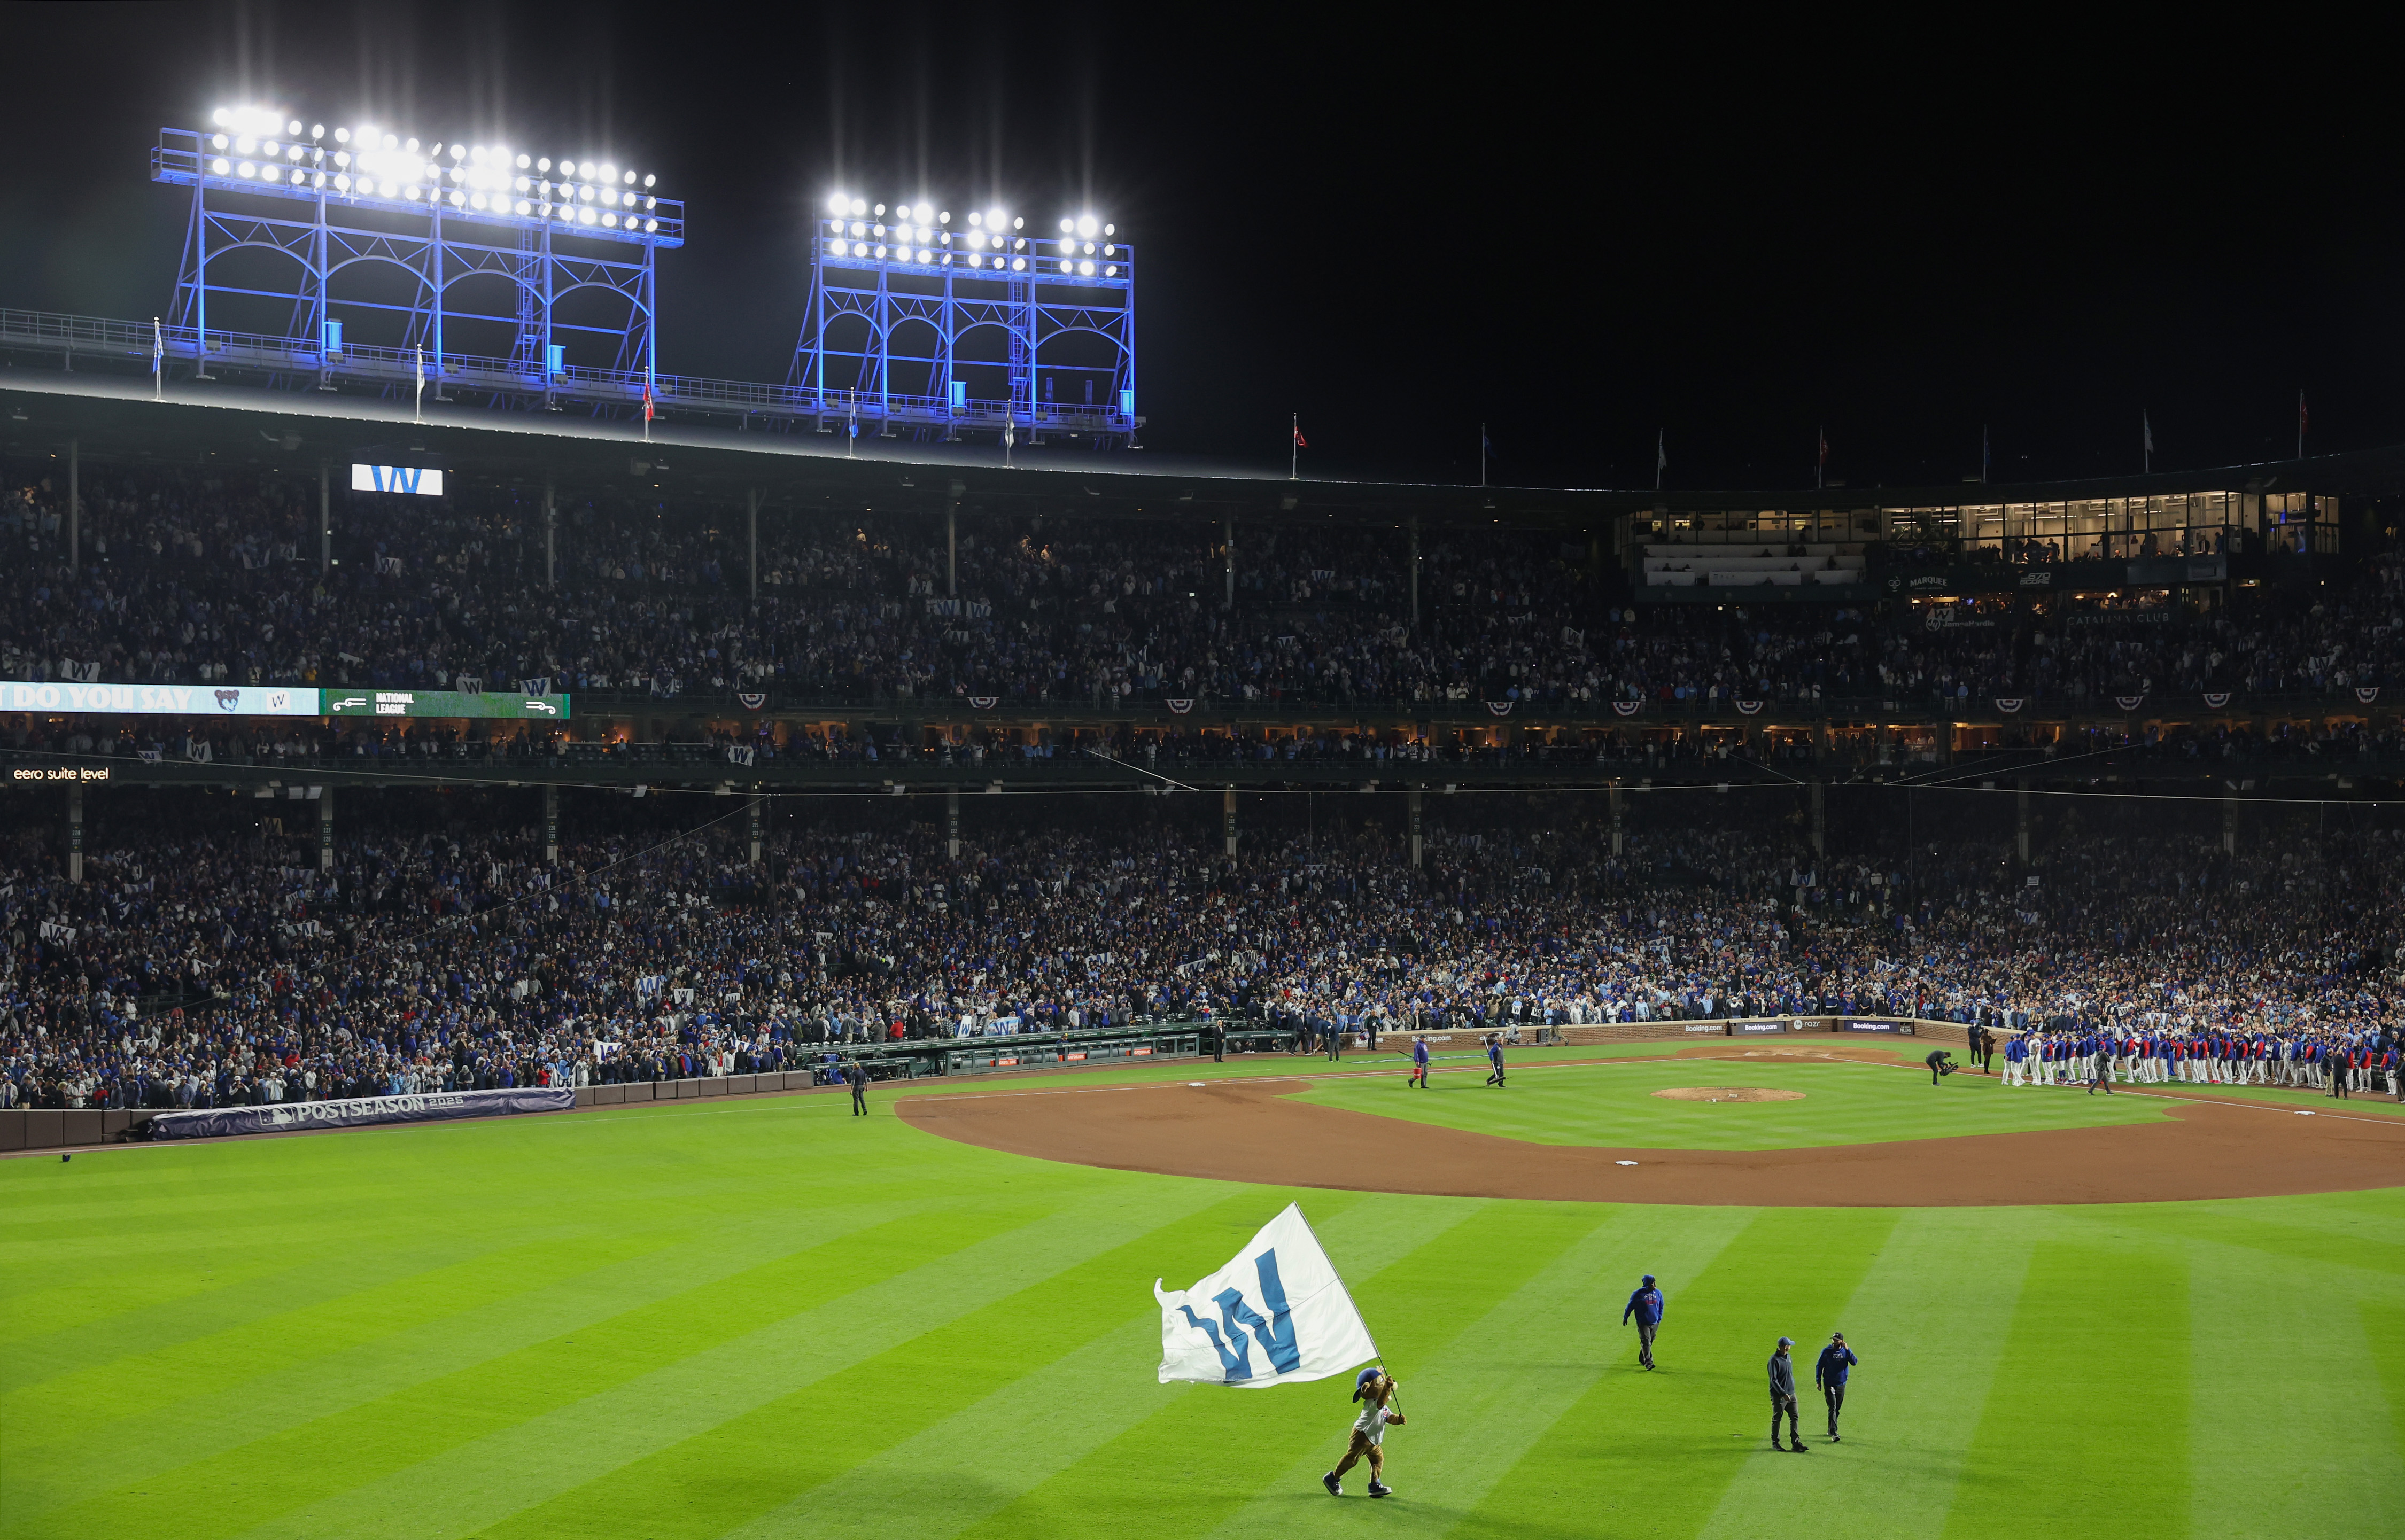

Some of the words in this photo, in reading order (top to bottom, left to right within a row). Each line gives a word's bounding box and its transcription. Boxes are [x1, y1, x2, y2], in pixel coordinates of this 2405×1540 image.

[371, 465, 422, 493] W
[1910, 577, 1948, 588] MARQUEE
[1934, 610, 1950, 620] W
[2137, 613, 2169, 623] CLUB
[72, 662, 92, 680] W
[463, 681, 480, 694] W
[523, 679, 545, 697] W
[15, 686, 60, 708] DO
[67, 687, 133, 710] YOU
[141, 688, 193, 711] SAY
[271, 694, 284, 707] W
[376, 693, 414, 703] NATIONAL
[376, 704, 406, 714] LEAGUE
[192, 742, 205, 760] W
[734, 748, 748, 763] W
[13, 769, 44, 780] eero
[47, 766, 77, 780] suite
[81, 767, 110, 780] level
[640, 977, 660, 998] W
[961, 1024, 970, 1035] W
[994, 1022, 1010, 1036] W
[1853, 1022, 1890, 1030] Booking.com
[299, 1097, 425, 1120] POSTSEASON
[430, 1096, 464, 1107] 2025
[1175, 1247, 1300, 1383] W
